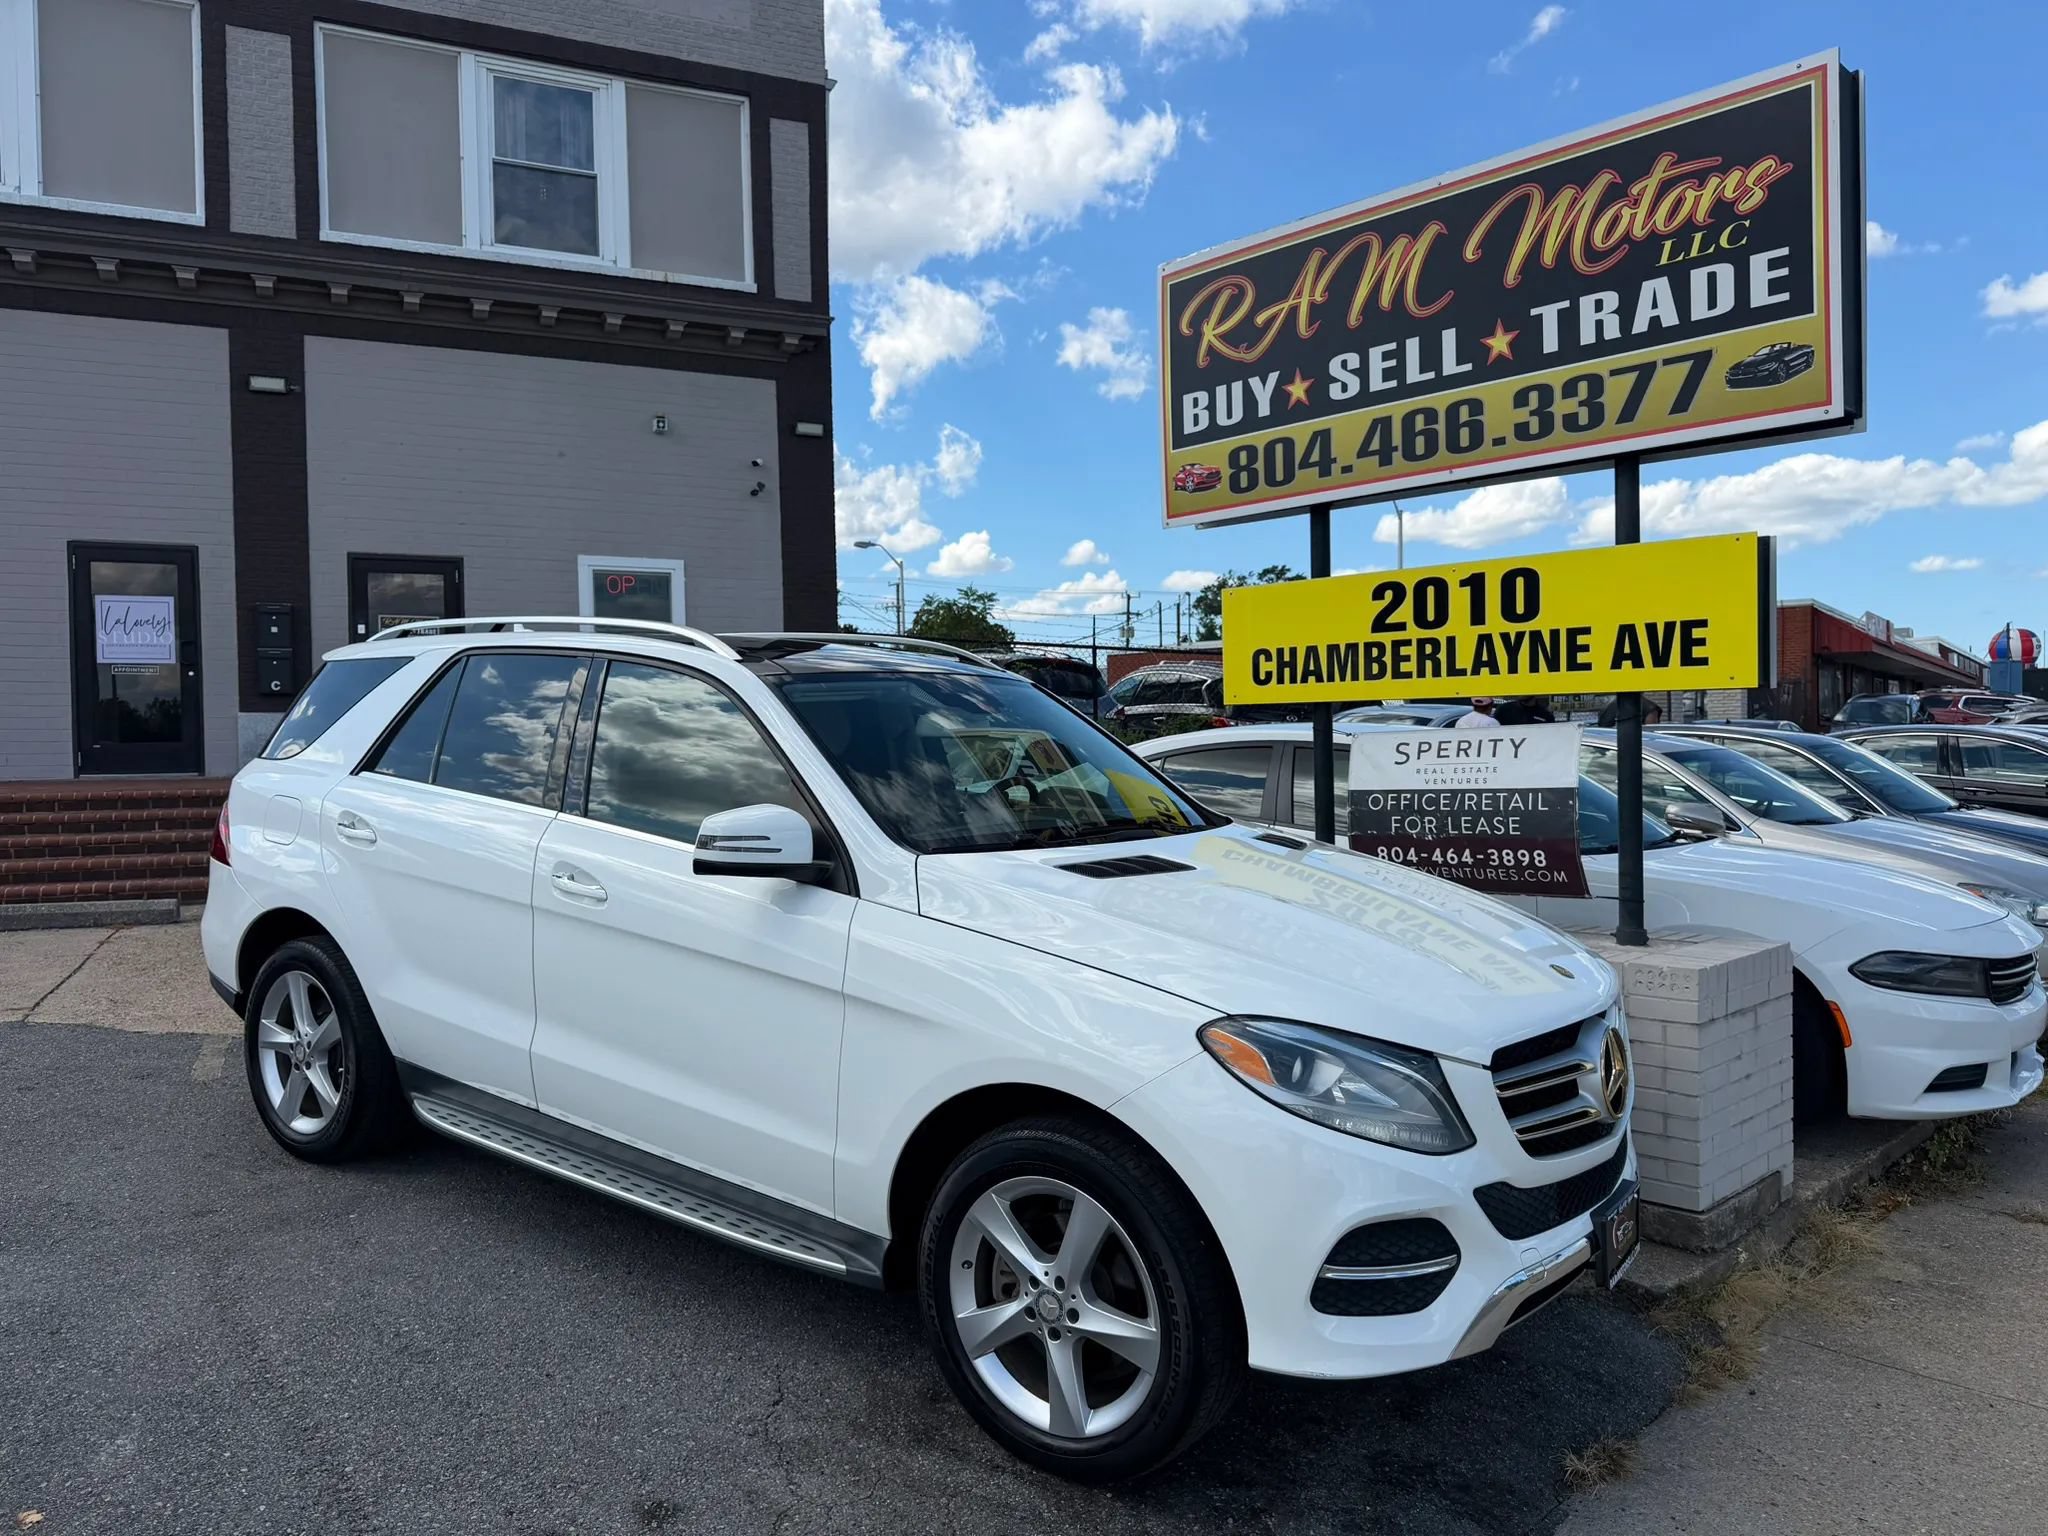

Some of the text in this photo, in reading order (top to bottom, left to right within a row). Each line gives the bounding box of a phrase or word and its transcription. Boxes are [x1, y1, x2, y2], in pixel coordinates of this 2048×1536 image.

[1654, 219, 1750, 267] LLC
[1179, 151, 1793, 367] RAM Motors
[1183, 246, 1791, 435] BUY SELL TRADE
[1227, 348, 1718, 495] 804.466.3377
[1370, 567, 1541, 634] 2010
[1251, 619, 1709, 687] CHAMBERLAYNE AVE
[271, 681, 281, 691] C
[1394, 737, 1527, 765] SPERITY
[1416, 766, 1498, 775] REAL ESTATE
[1424, 777, 1488, 785] VENTURES
[1368, 792, 1549, 812] OFFICE/RETAIL
[1391, 816, 1521, 835] FOR LEASE
[1377, 846, 1547, 868] 804-464-3898
